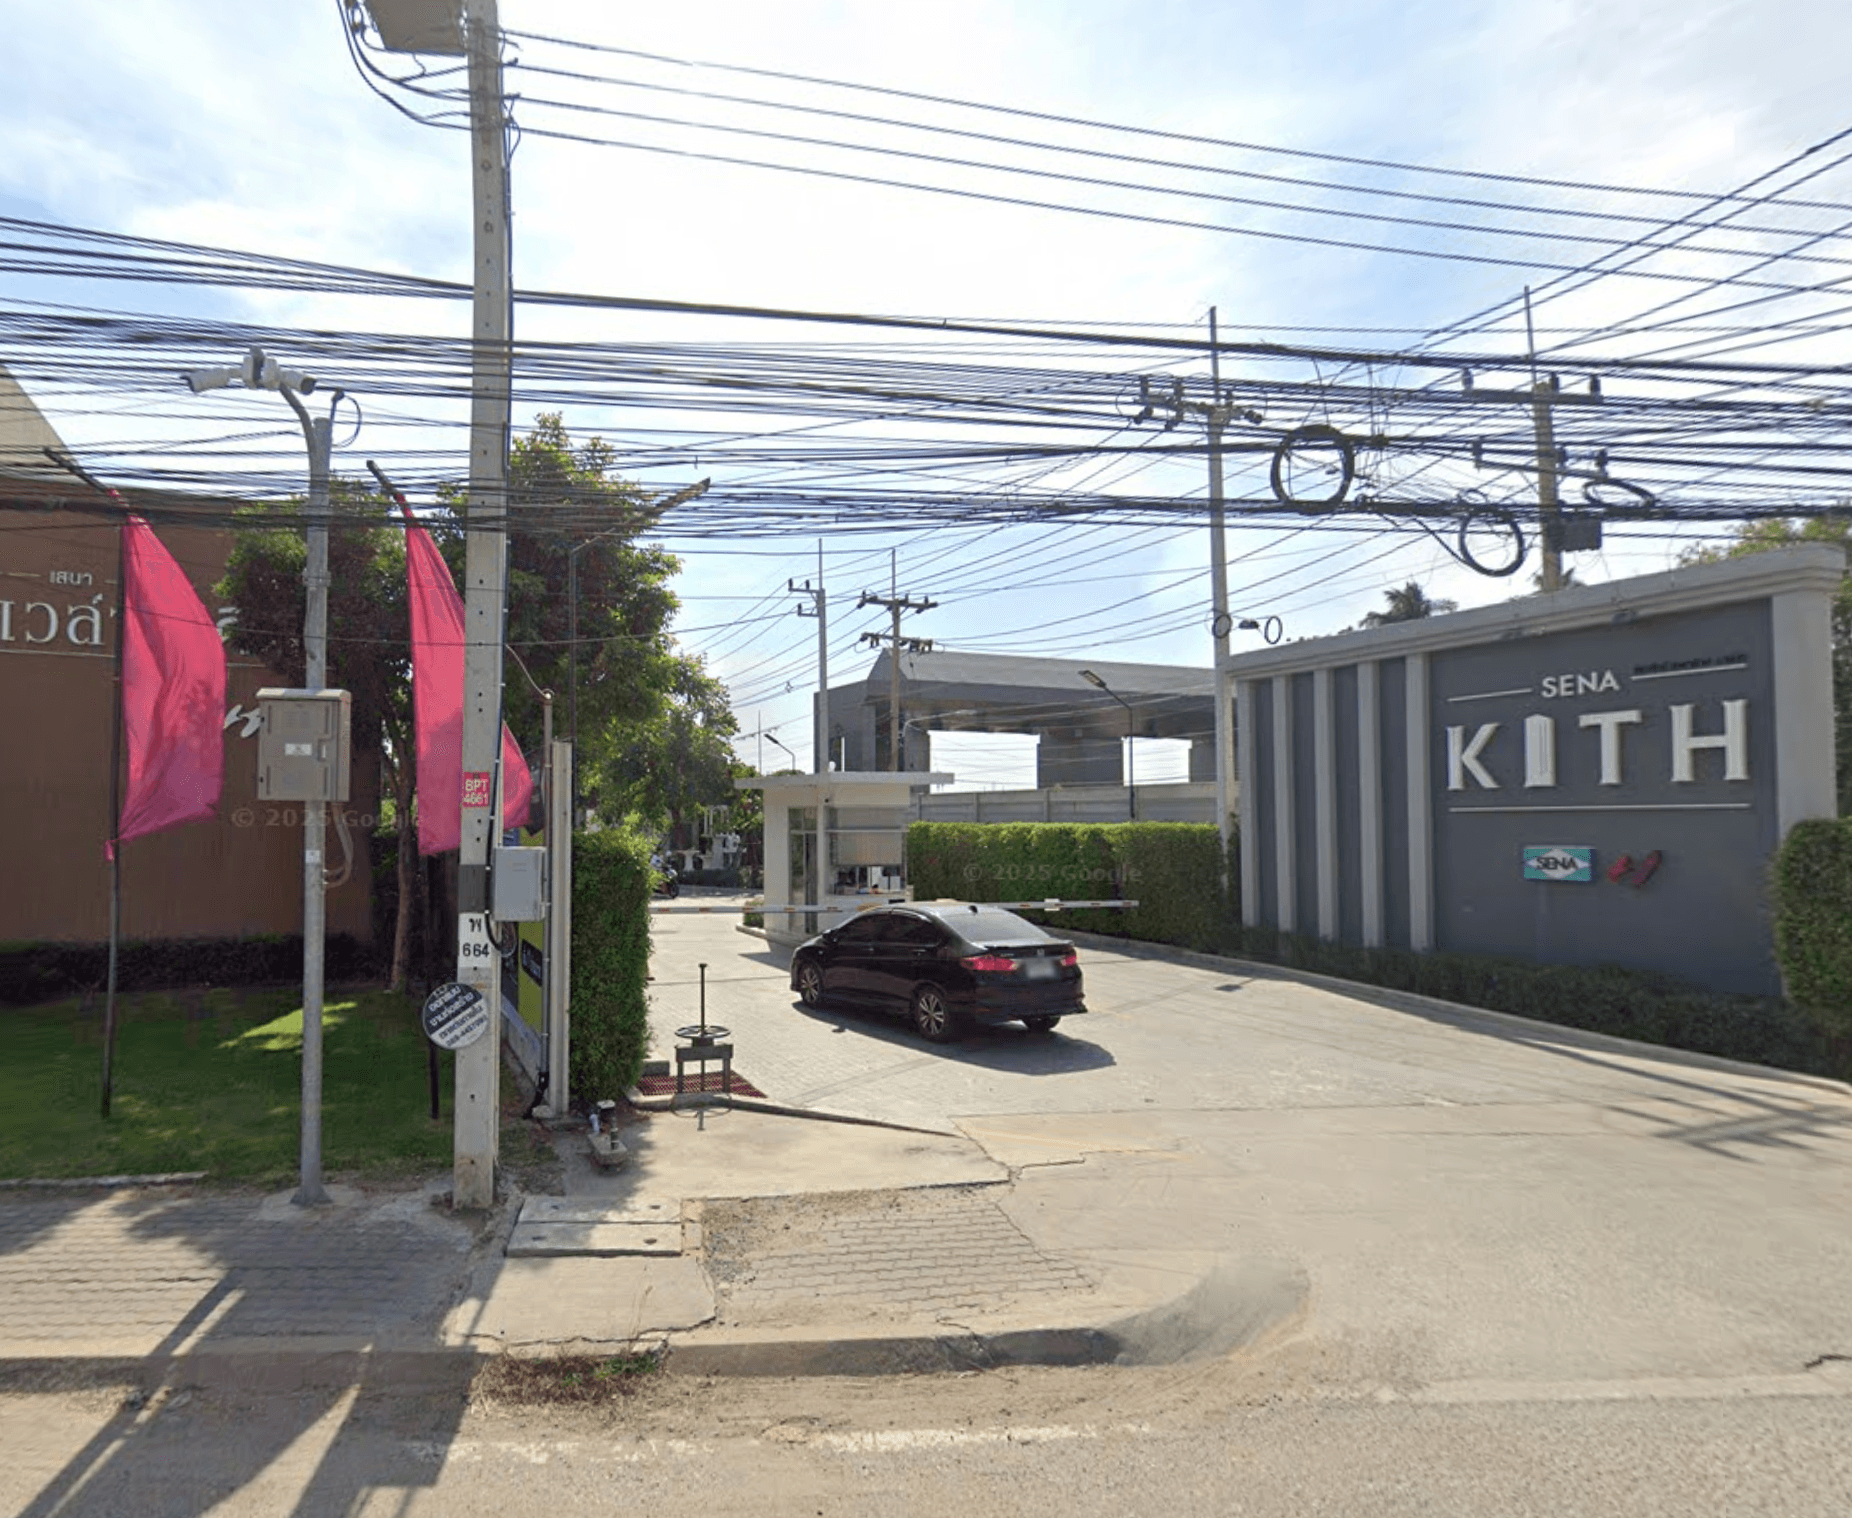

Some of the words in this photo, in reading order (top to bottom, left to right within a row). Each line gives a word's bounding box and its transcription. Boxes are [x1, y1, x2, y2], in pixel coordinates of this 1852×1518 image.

[1541, 670, 1621, 698] SENA
[1446, 699, 1749, 791] KITH
[1536, 856, 1579, 870] SENA
[463, 943, 490, 957] 664
